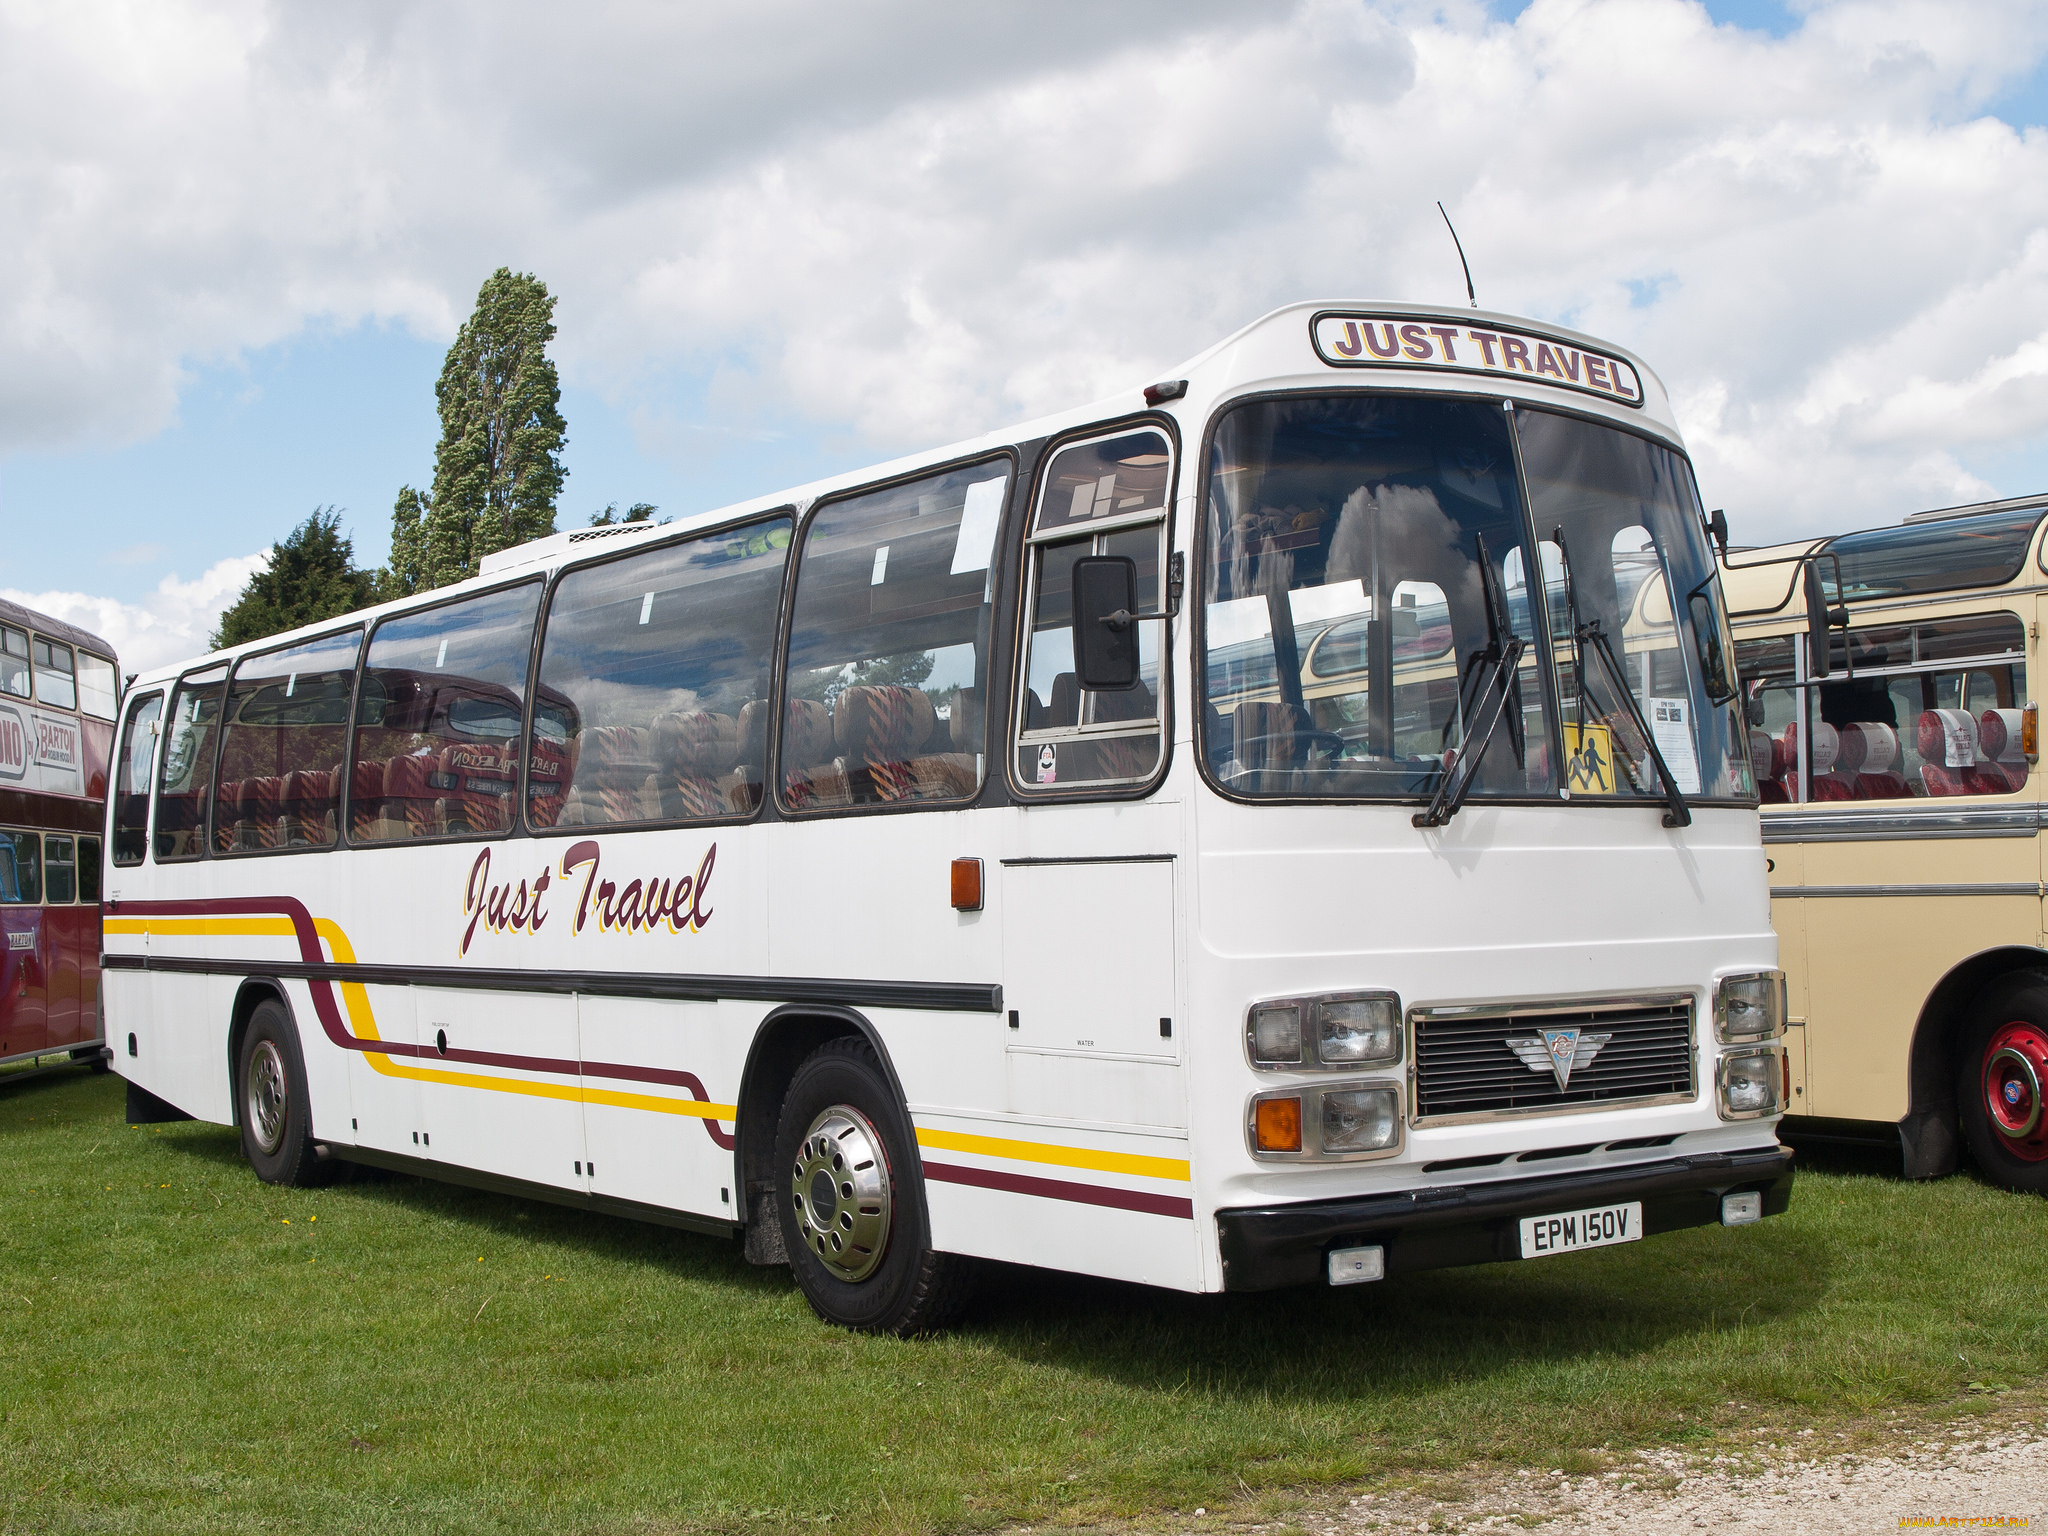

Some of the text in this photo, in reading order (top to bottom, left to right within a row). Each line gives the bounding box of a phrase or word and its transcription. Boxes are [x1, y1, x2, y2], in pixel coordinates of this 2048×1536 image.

[1333, 321, 1635, 398] JUST TRAVEL
[40, 723, 75, 764] BARTON
[459, 840, 717, 960] Just Travel
[1077, 1039, 1094, 1047] WATER
[1533, 1208, 1628, 1251] EPM 150V
